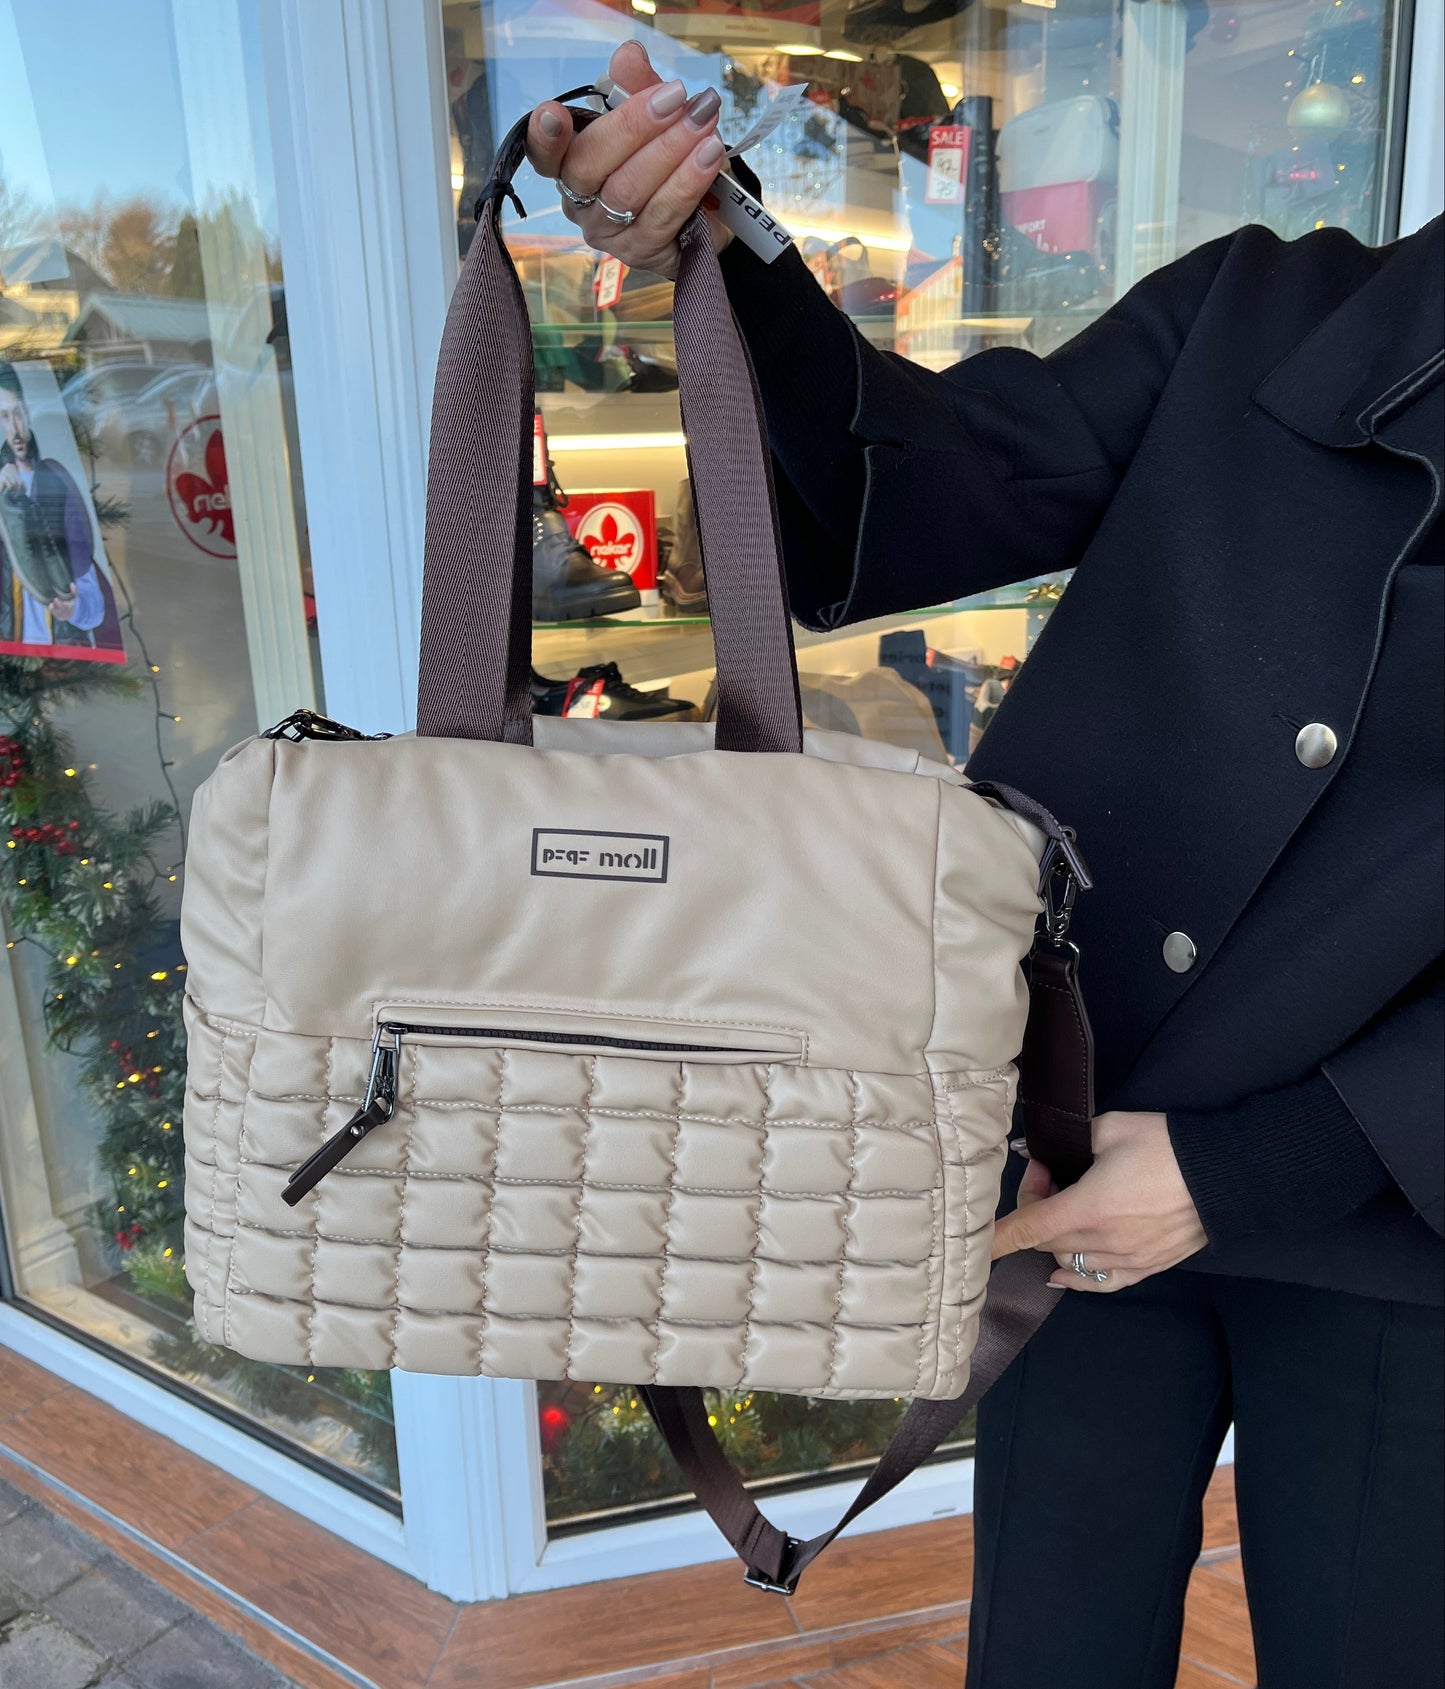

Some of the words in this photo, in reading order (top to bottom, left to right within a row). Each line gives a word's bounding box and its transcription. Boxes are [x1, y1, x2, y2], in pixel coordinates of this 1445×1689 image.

[931, 130, 964, 146] SALE
[729, 187, 792, 247] PEPE
[599, 847, 657, 870] moll
